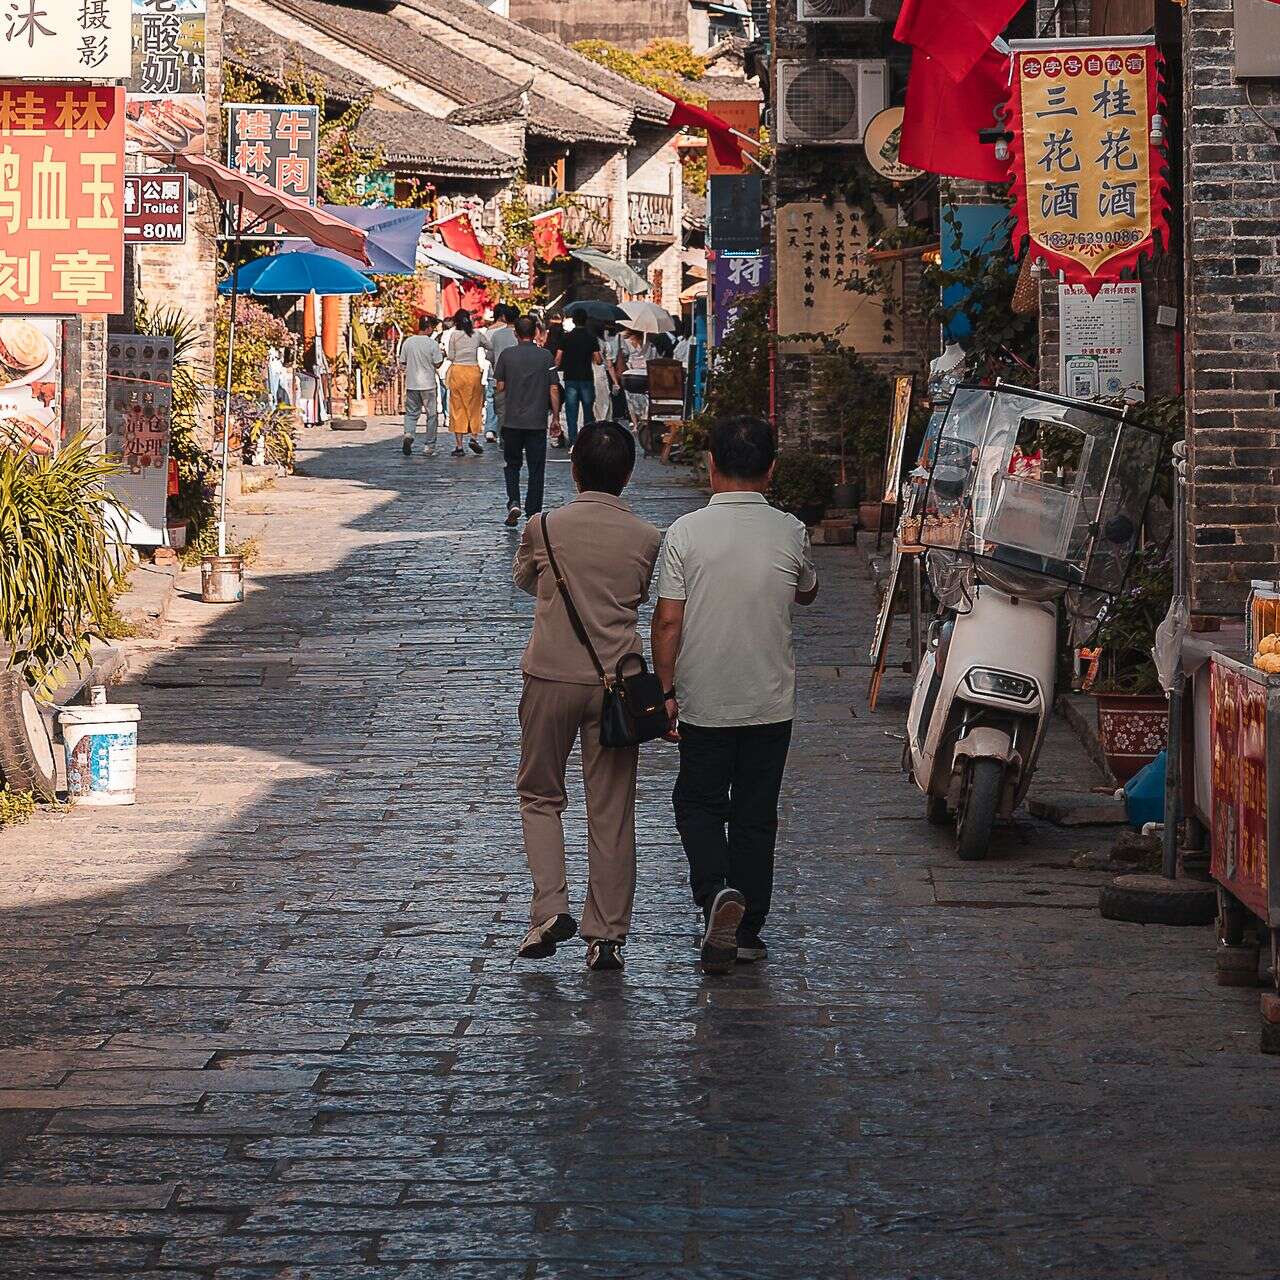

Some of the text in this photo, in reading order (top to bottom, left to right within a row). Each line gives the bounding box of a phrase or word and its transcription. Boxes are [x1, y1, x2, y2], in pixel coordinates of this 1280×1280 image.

[1024, 56, 1143, 76] 老字号自酿酒
[1036, 86, 1081, 220] 三花酒
[1092, 79, 1139, 220] 桂花酒
[142, 181, 181, 200] 公厕
[143, 202, 179, 214] Toilet
[143, 224, 182, 238] 80M
[127, 414, 165, 433] 清仓
[126, 438, 163, 456] 处理
